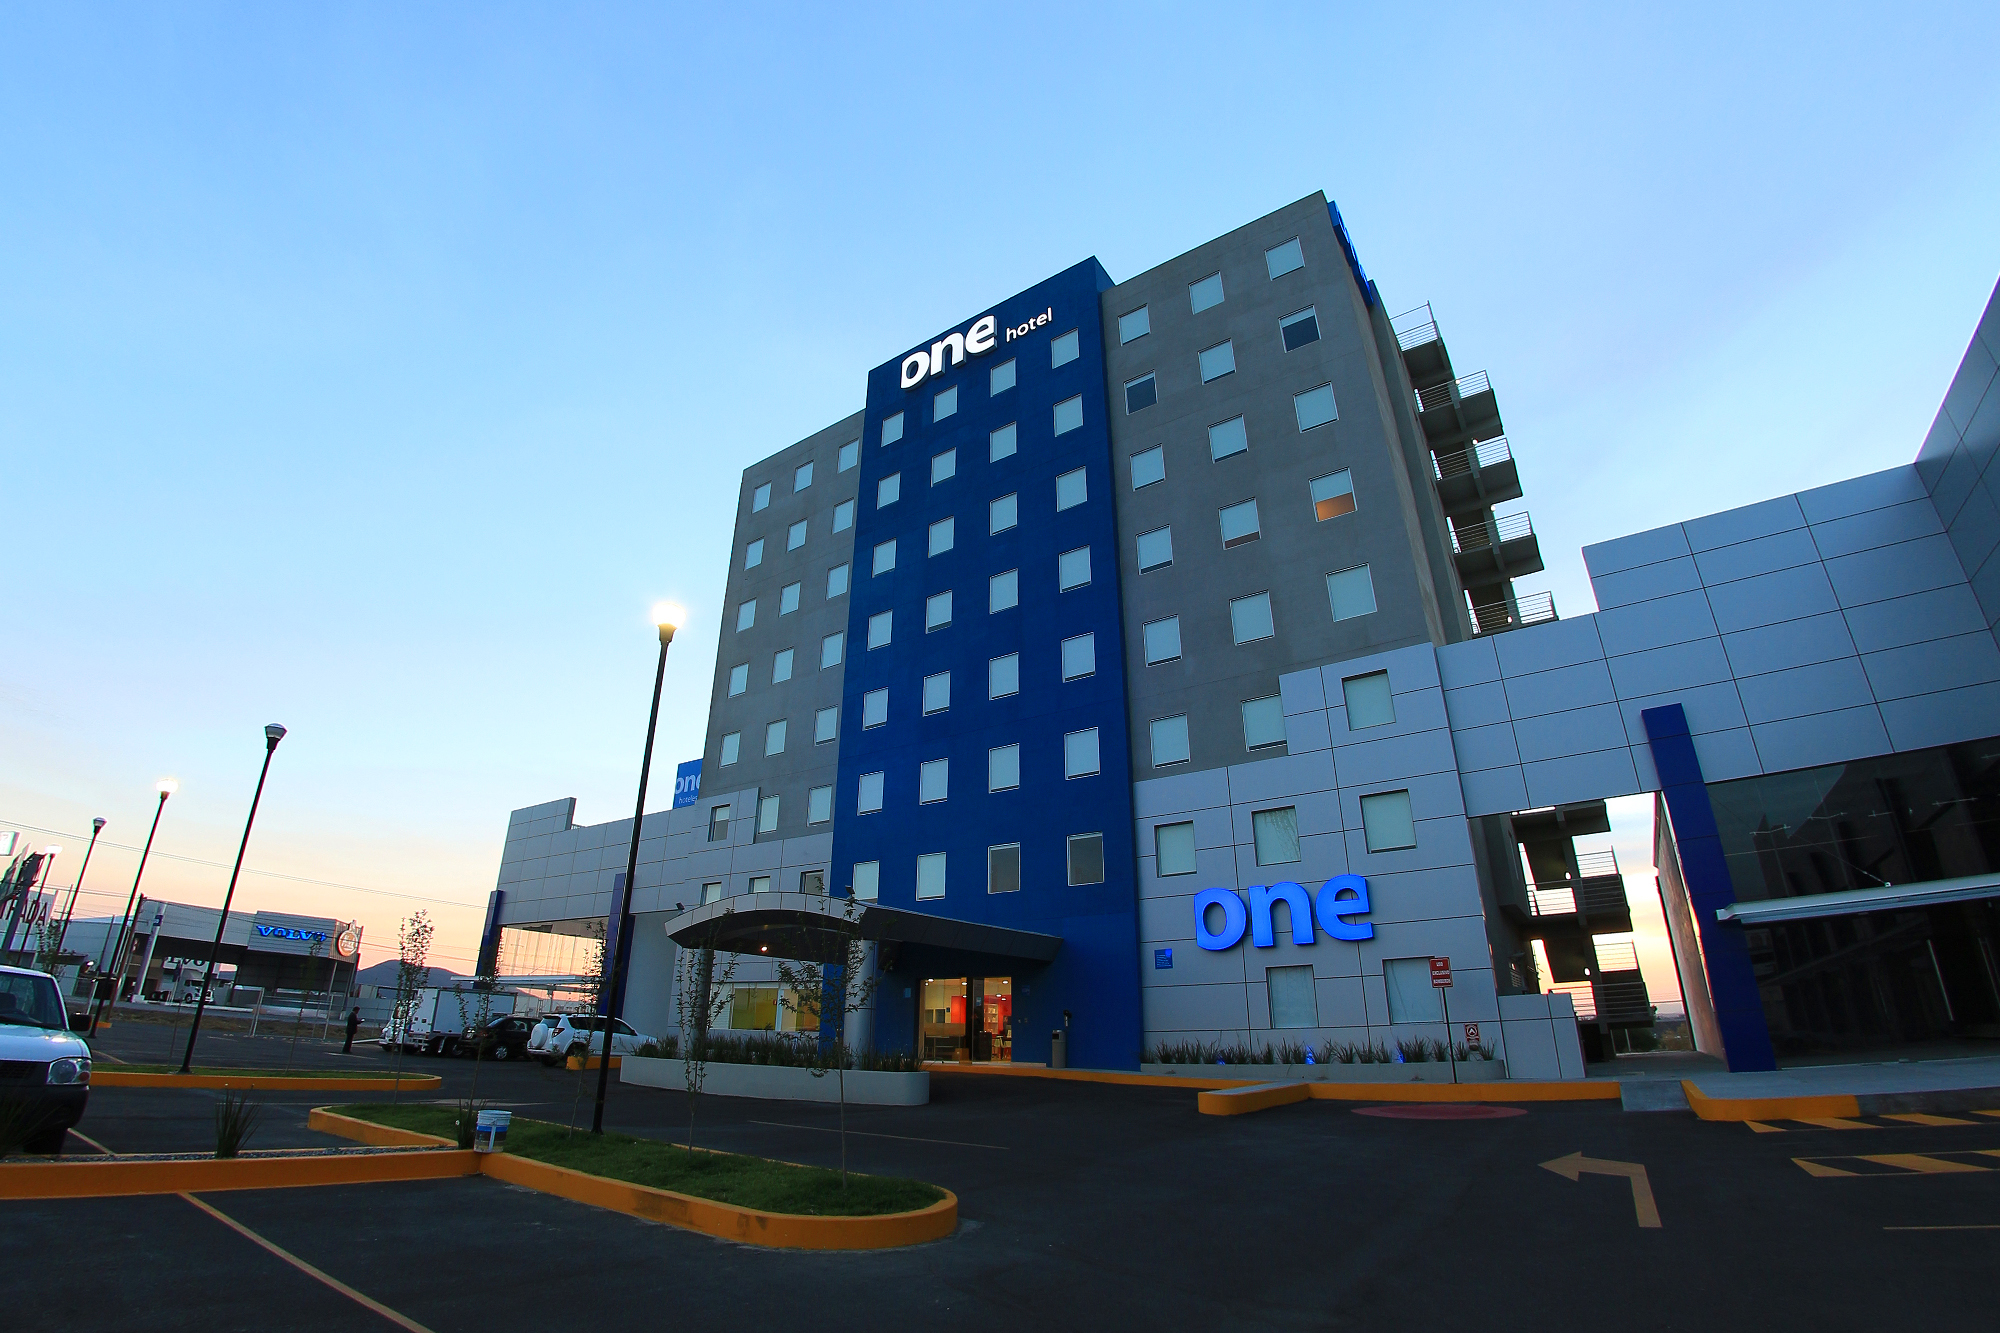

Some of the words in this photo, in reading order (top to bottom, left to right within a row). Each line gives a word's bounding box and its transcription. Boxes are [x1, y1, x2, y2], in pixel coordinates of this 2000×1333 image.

[901, 315, 997, 389] one
[1006, 307, 1052, 342] hotel
[256, 925, 327, 942] VOLVO
[1194, 874, 1374, 951] one
